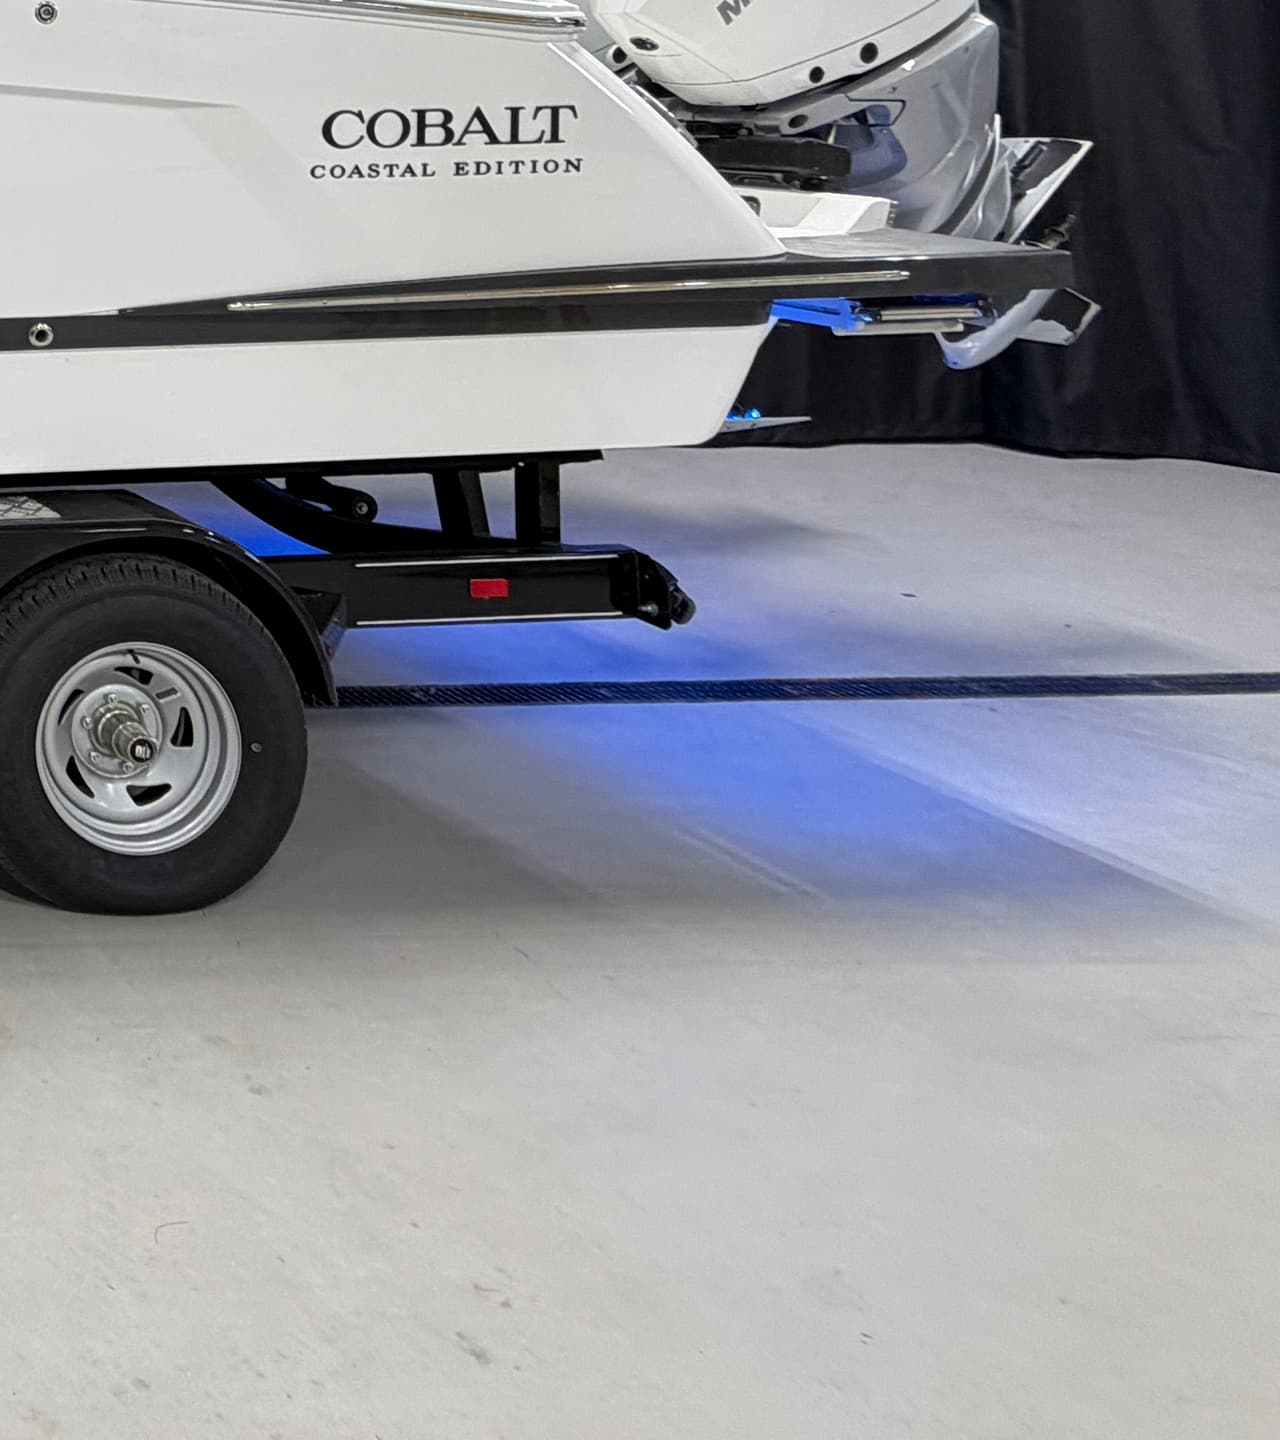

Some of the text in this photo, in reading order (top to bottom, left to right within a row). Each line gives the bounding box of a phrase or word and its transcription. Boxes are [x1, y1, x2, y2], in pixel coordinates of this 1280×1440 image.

[321, 105, 578, 150] COBALT
[309, 158, 584, 179] COASTAL EDITION
